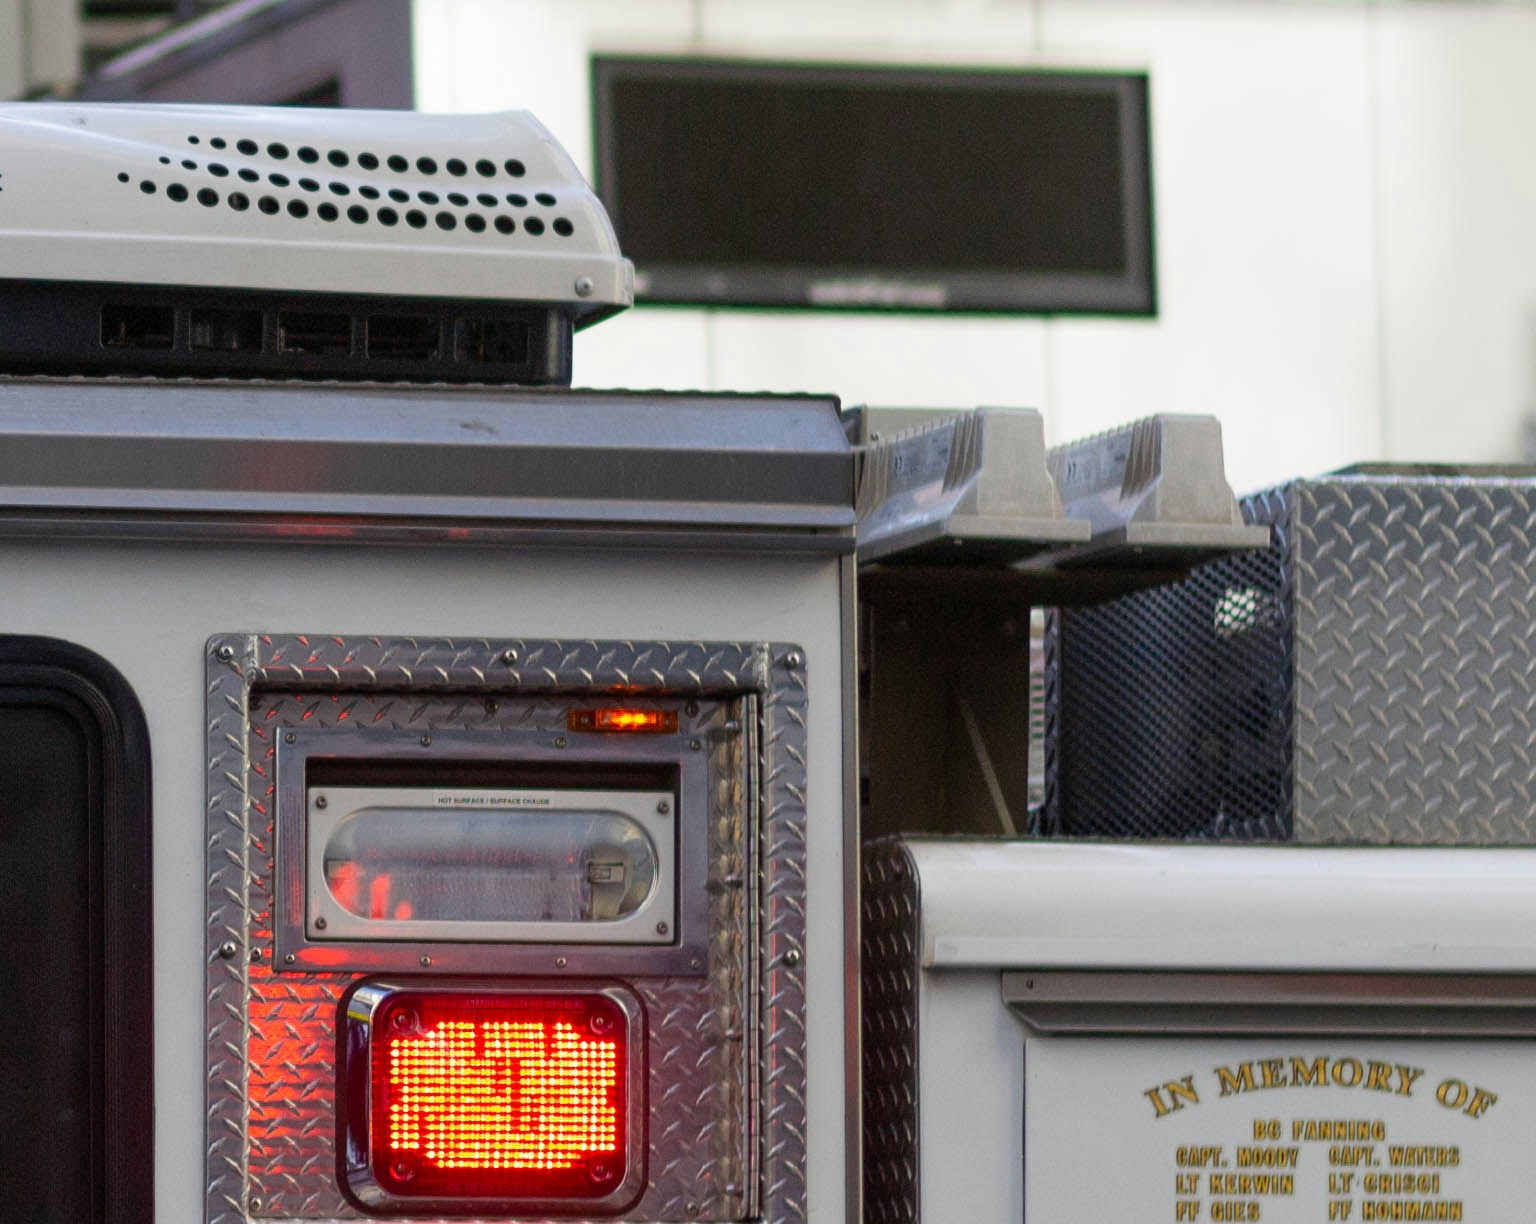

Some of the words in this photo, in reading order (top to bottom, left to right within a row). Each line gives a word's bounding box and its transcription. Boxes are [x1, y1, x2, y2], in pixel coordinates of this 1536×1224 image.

[1144, 1076, 1200, 1118] IN
[1213, 1057, 1424, 1096] MEMORY
[1436, 1080, 1498, 1118] OF
[1293, 1120, 1385, 1141] FANNING
[1177, 1146, 1227, 1167] CAPT.
[1237, 1147, 1298, 1167] MOODY
[1329, 1146, 1379, 1165] CAPT.
[1389, 1147, 1459, 1166] WATERS
[1176, 1174, 1198, 1194] LT
[1210, 1174, 1293, 1195] KERWIN
[1329, 1173, 1352, 1193] LT
[1176, 1201, 1199, 1221] FF
[1211, 1201, 1260, 1222] GIES
[1329, 1200, 1351, 1220] FF
[1363, 1201, 1462, 1221] HOHMANN
